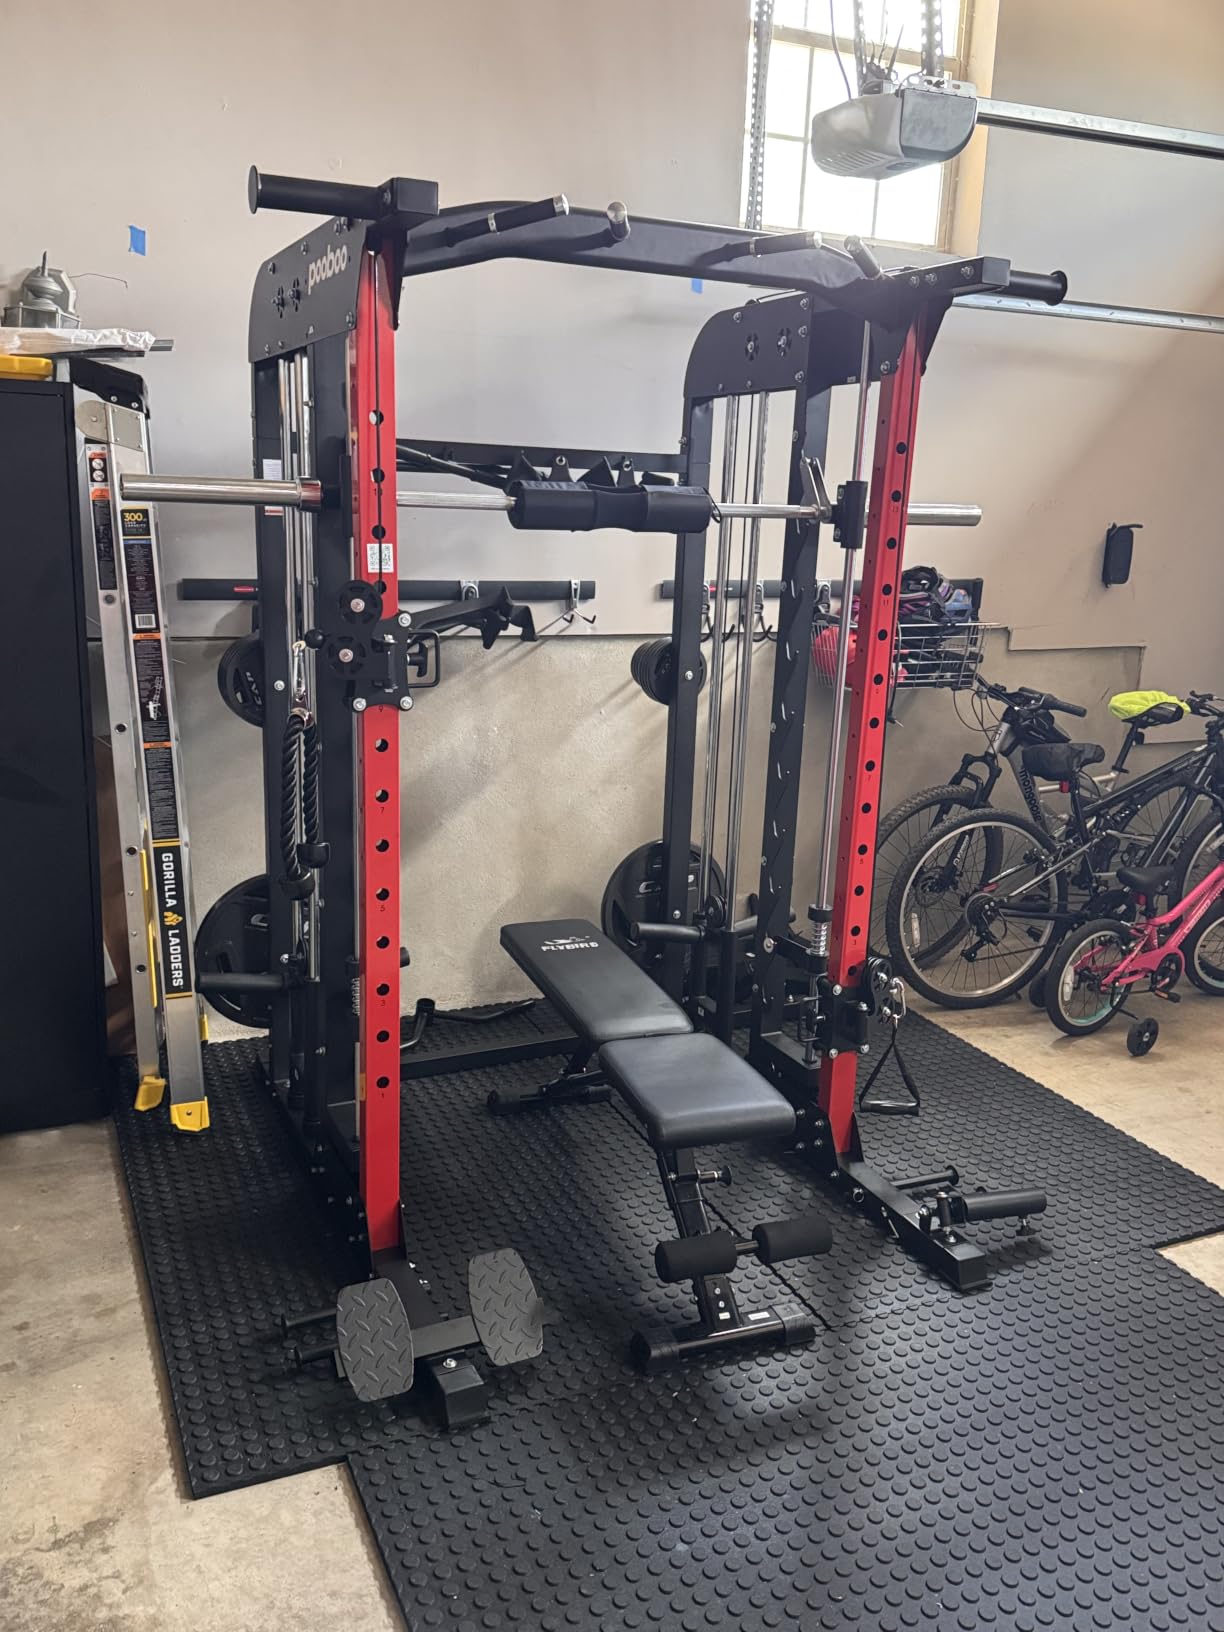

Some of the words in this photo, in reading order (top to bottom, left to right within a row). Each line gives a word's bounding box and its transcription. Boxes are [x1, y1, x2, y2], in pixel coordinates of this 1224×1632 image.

[307, 244, 348, 296] pooboo
[123, 512, 143, 522] 300
[379, 806, 386, 814] 7
[161, 852, 177, 908] GORILLA
[379, 904, 386, 912] 5
[541, 941, 599, 952] FLYBIRD
[168, 929, 184, 987] LADDERS
